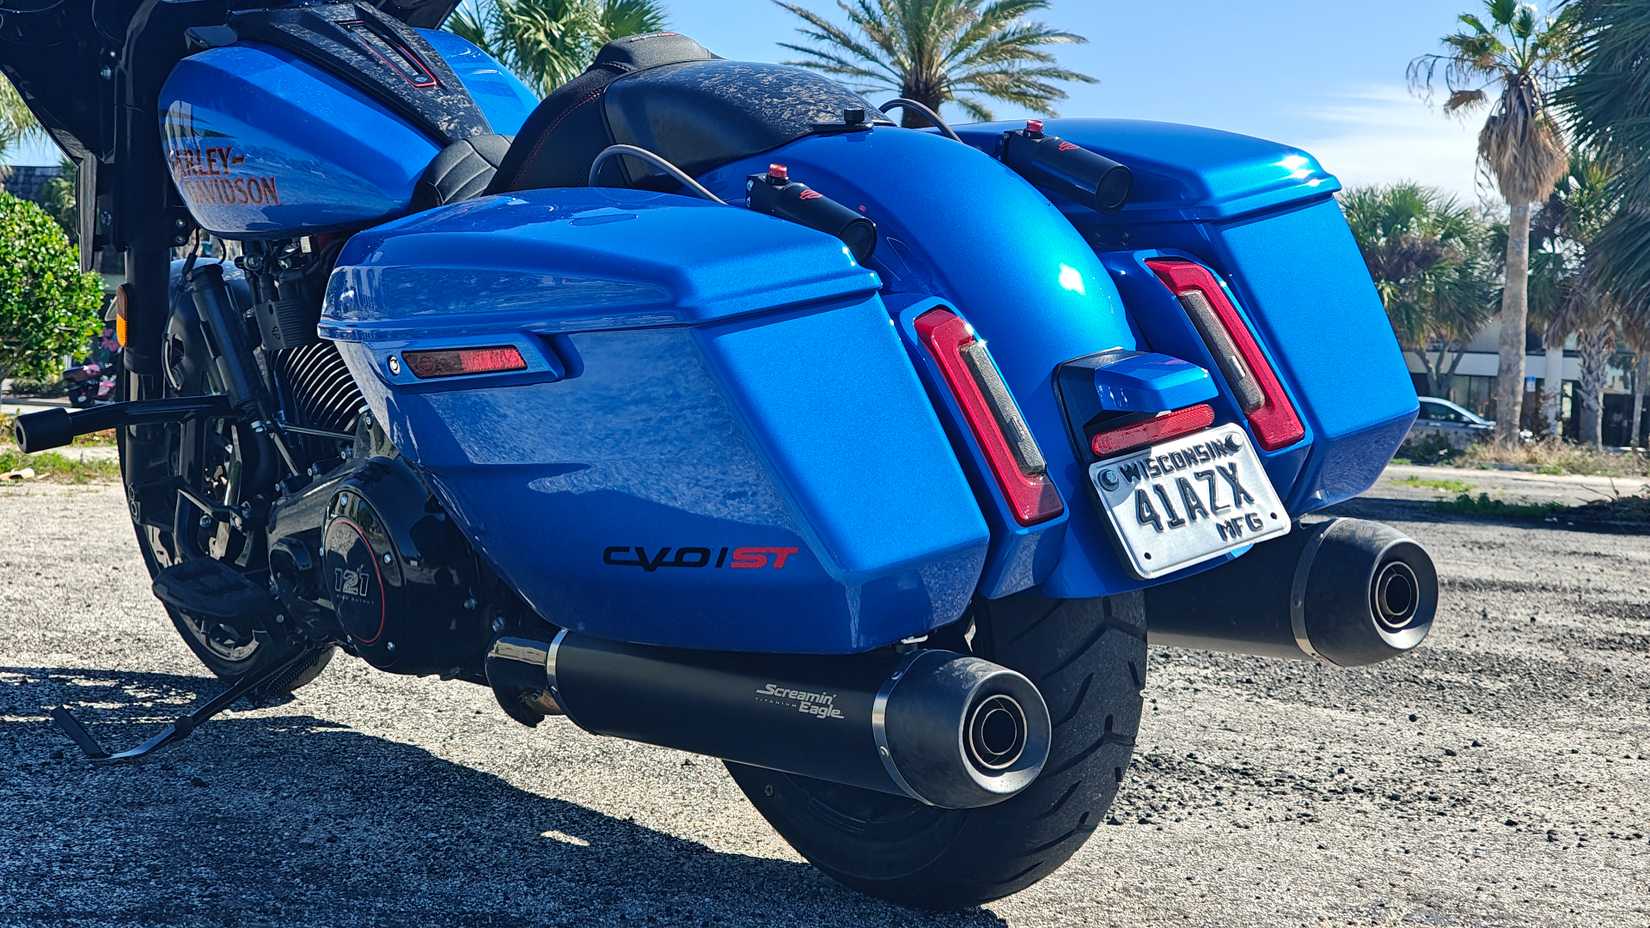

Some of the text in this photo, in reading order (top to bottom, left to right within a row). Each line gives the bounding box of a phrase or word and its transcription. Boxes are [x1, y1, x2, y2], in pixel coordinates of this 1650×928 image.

[1119, 435, 1230, 483] WISCONSIN
[1134, 462, 1255, 534] 41AZX
[1215, 512, 1264, 542] MFG
[730, 546, 800, 569] ST
[334, 567, 370, 597] 121
[756, 683, 838, 705] Screamin'
[798, 701, 845, 719] Eagle
